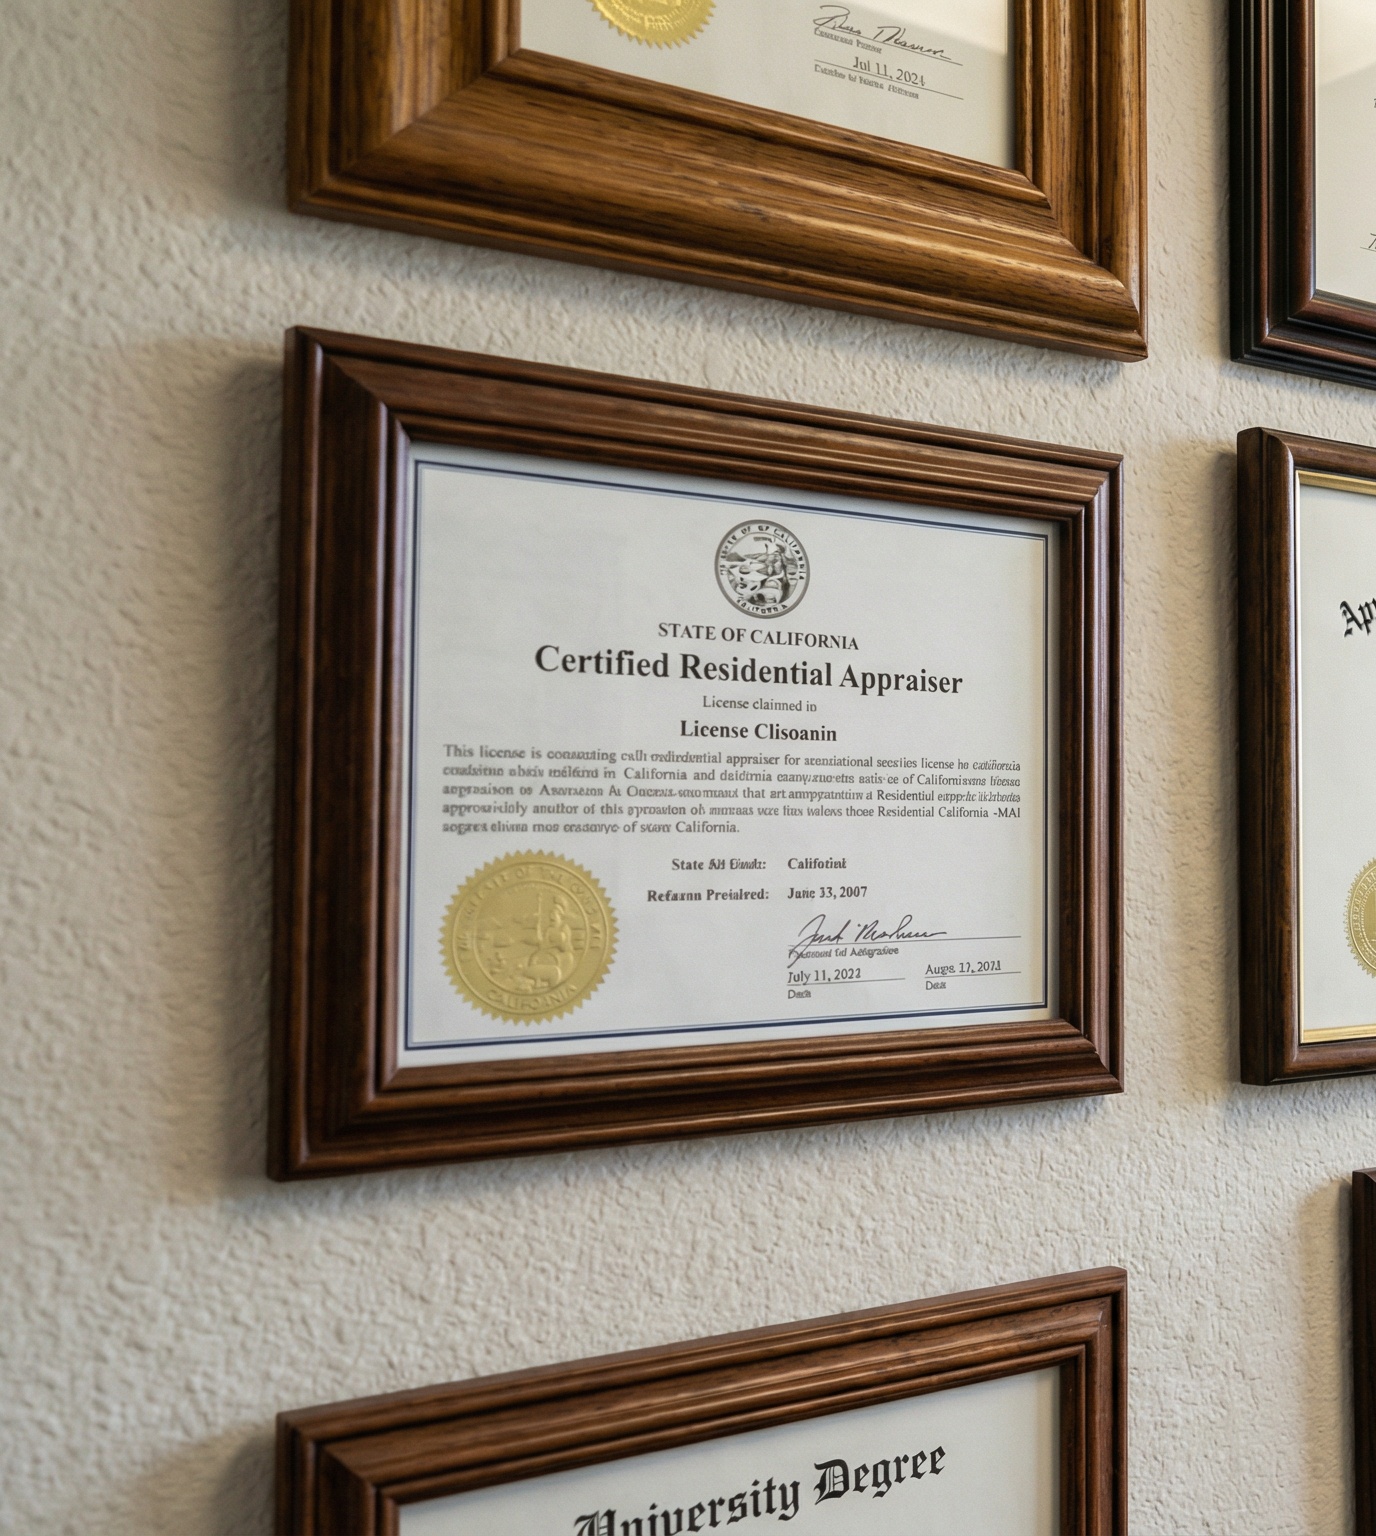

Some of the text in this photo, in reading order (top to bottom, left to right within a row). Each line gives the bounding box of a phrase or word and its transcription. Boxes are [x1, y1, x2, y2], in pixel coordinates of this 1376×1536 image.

[853, 56, 870, 73] Jul
[658, 622, 860, 651] STATE OF CALIFORNIA
[535, 644, 963, 697] Certified Residential Appraiser
[703, 695, 750, 710] License
[680, 719, 838, 742] License Clisoanin
[443, 744, 474, 758] This
[530, 746, 543, 759] is
[726, 753, 780, 768] appraiser
[784, 754, 801, 766] for
[921, 758, 954, 770] license
[623, 767, 688, 780] California
[693, 769, 715, 781] and
[902, 774, 915, 785] of
[742, 787, 766, 799] that
[600, 803, 624, 816] this
[622, 821, 638, 833] of
[675, 821, 741, 834] California.
[671, 858, 704, 871] State
[839, 885, 868, 899] 2007
[787, 971, 812, 986] July
[574, 1445, 947, 1536] University Degree
